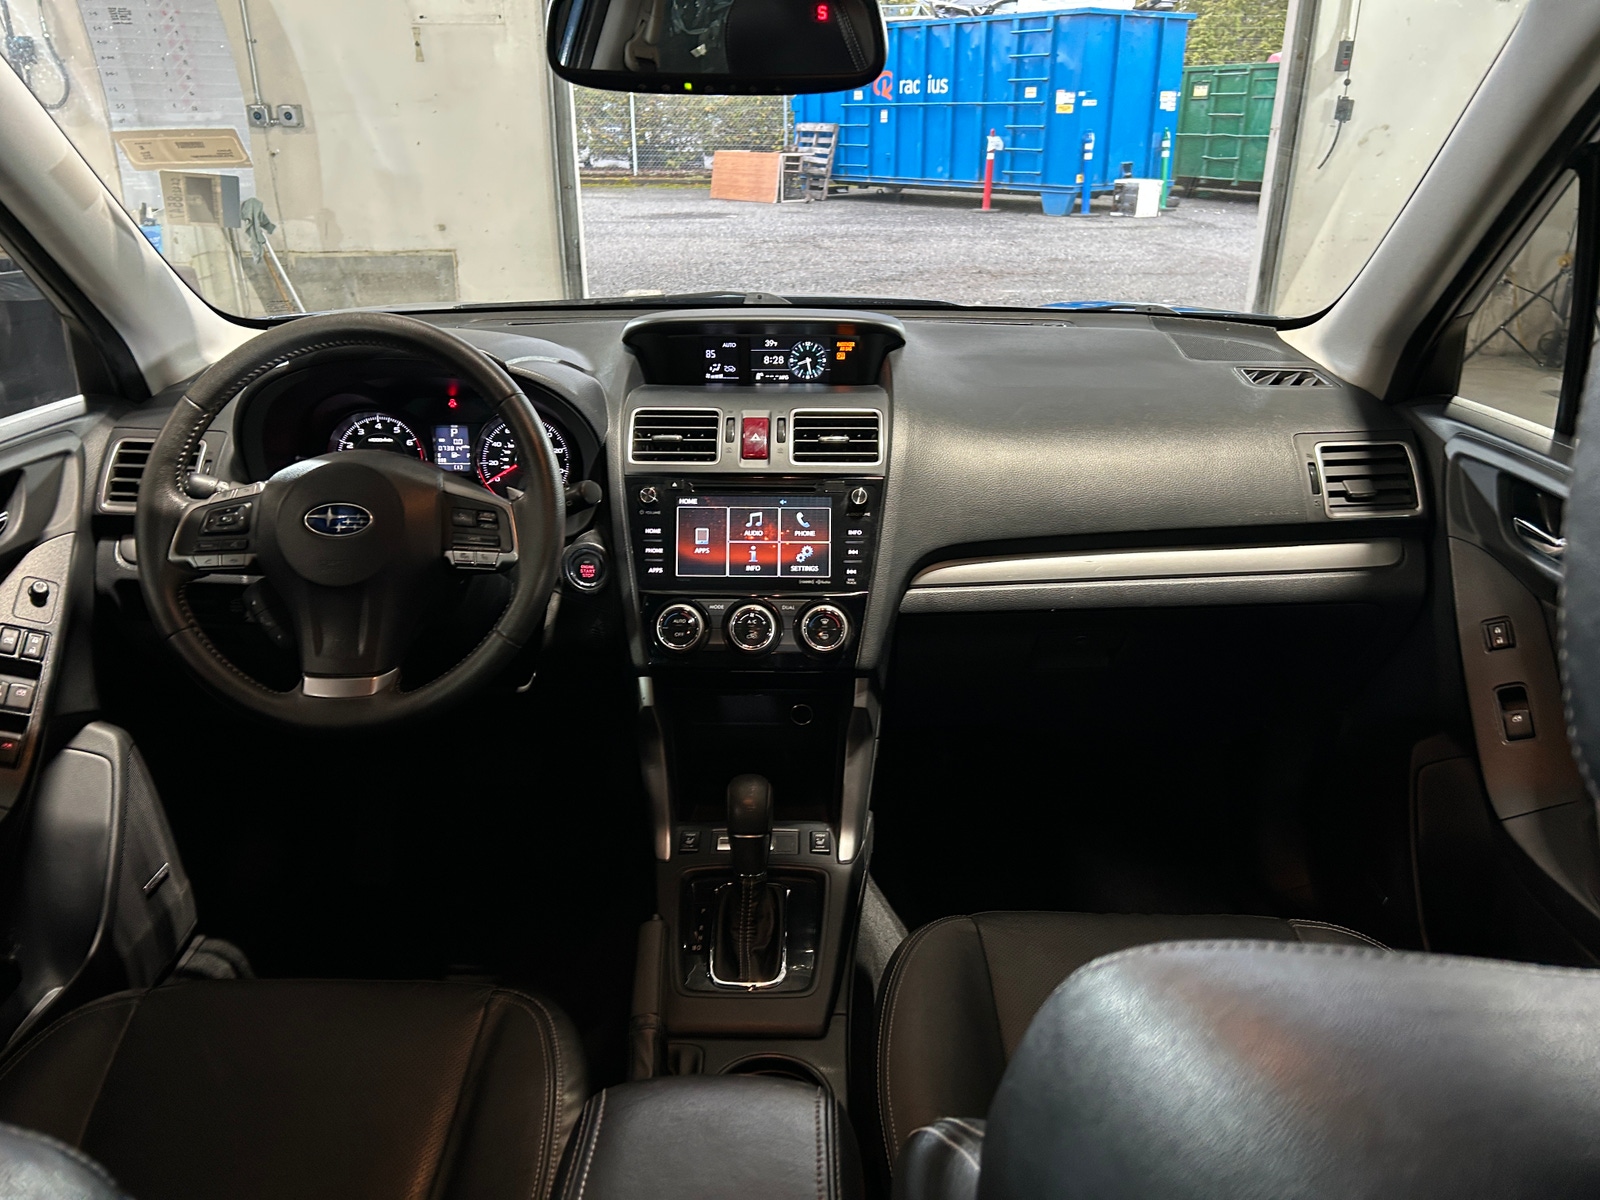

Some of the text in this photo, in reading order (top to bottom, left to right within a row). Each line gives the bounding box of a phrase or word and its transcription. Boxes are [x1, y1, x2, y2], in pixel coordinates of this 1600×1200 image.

[817, 5, 828, 20] S
[705, 349, 716, 358] 85
[763, 355, 784, 364] 8:28
[393, 426, 401, 434] 5
[450, 428, 458, 437] P
[346, 441, 354, 449] 2
